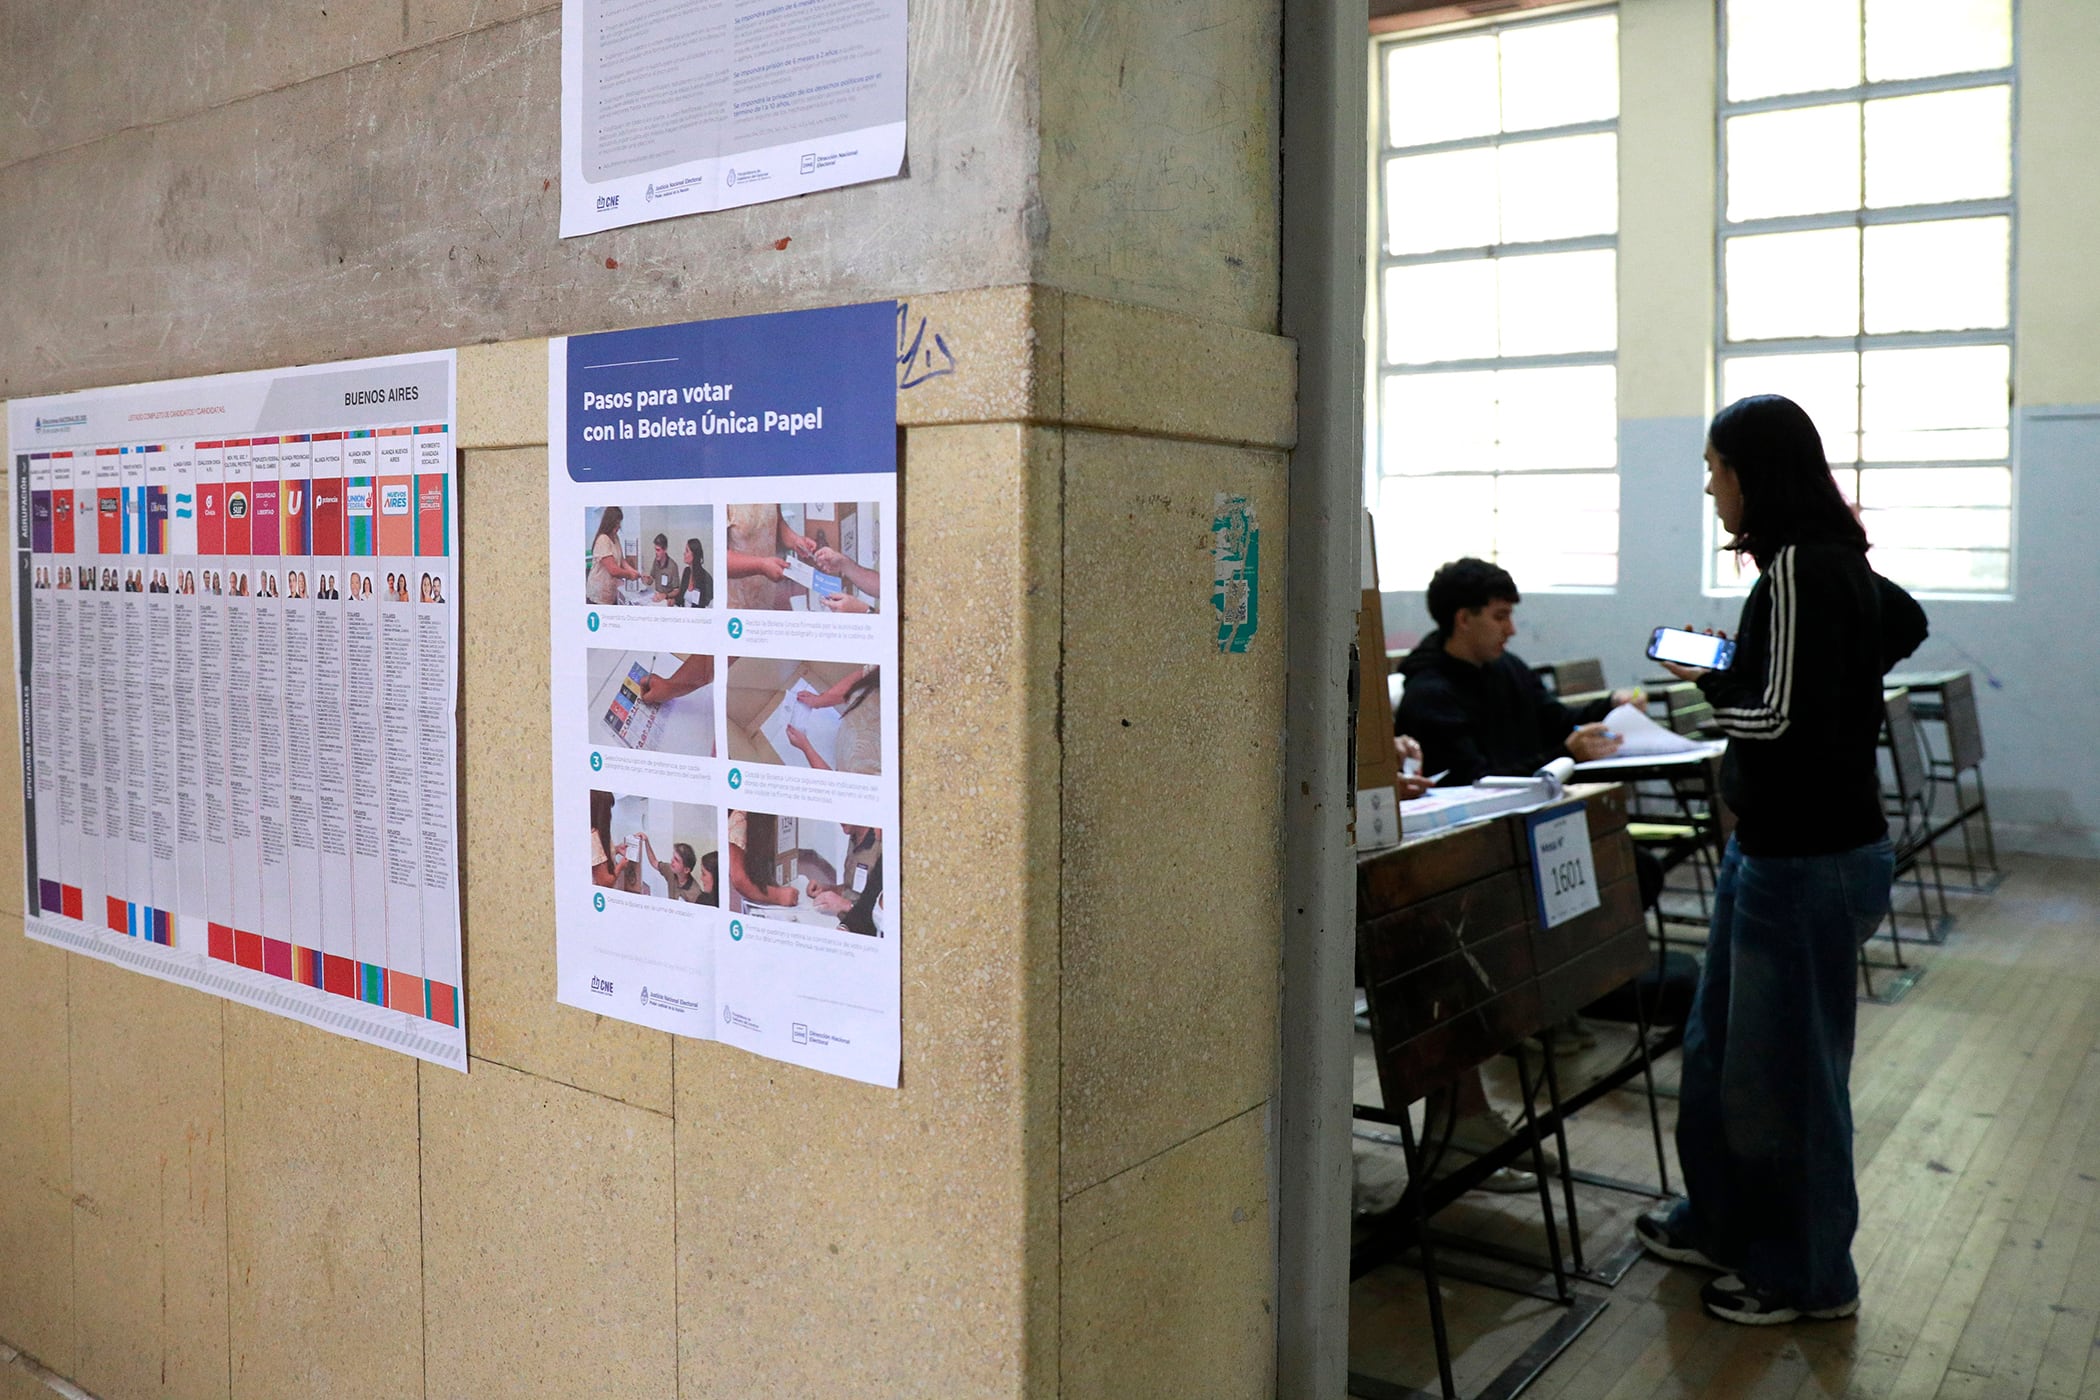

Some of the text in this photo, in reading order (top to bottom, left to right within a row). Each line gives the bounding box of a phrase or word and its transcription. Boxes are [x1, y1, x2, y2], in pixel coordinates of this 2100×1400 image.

[606, 195, 620, 208] CNE
[345, 386, 418, 406] BUENOS AIRES
[584, 382, 732, 411] Pasos para votar
[584, 406, 822, 441] con la Boleta Única Papel
[19, 476, 28, 538] AGRUPACIÓN
[288, 490, 302, 515] U
[384, 498, 406, 508] AIRES
[732, 622, 739, 634] 2
[592, 756, 599, 767] 3
[731, 773, 739, 784] 4
[1551, 858, 1585, 895] 1601
[596, 896, 603, 908] 5
[732, 925, 739, 936] 6
[601, 980, 613, 993] CNE
